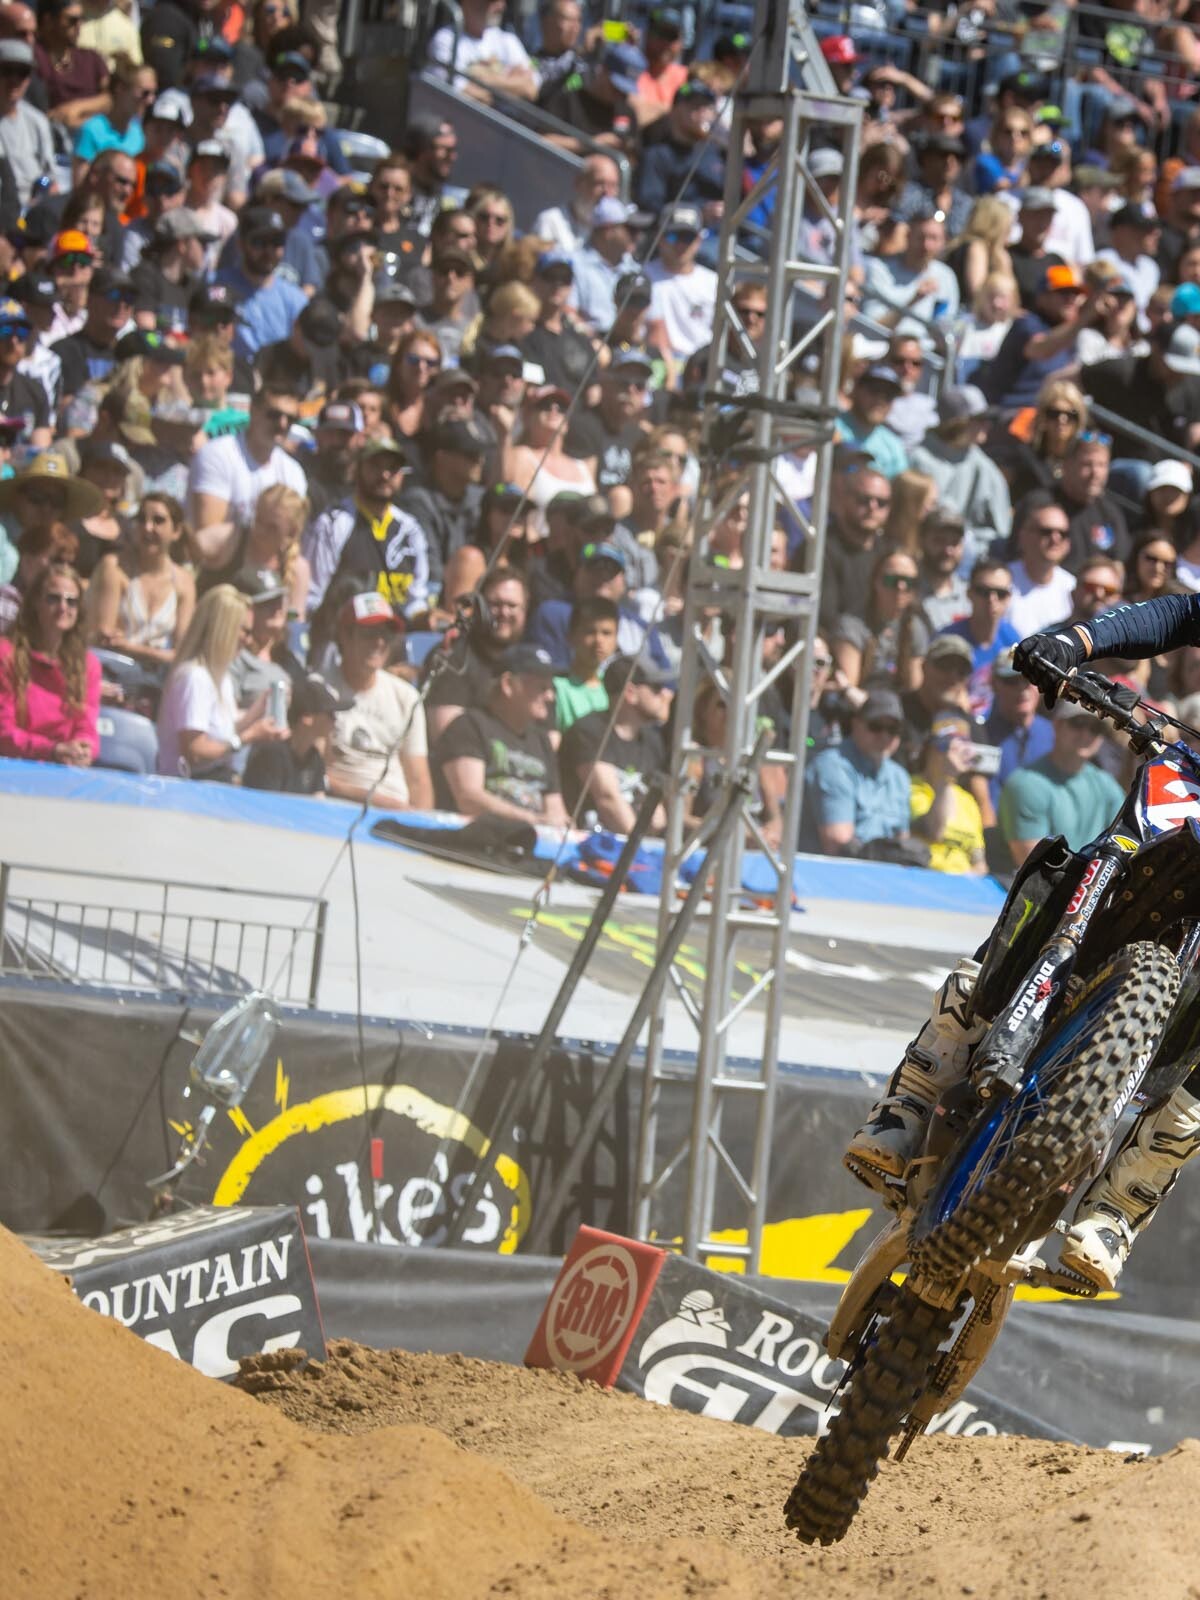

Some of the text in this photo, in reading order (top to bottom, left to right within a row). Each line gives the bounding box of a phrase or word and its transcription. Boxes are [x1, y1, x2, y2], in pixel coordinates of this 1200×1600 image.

[1007, 960, 1056, 1033] DUNLOP
[305, 1151, 501, 1248] ike's
[80, 1234, 294, 1328] OUNTAIN
[735, 1310, 852, 1397] ROC
